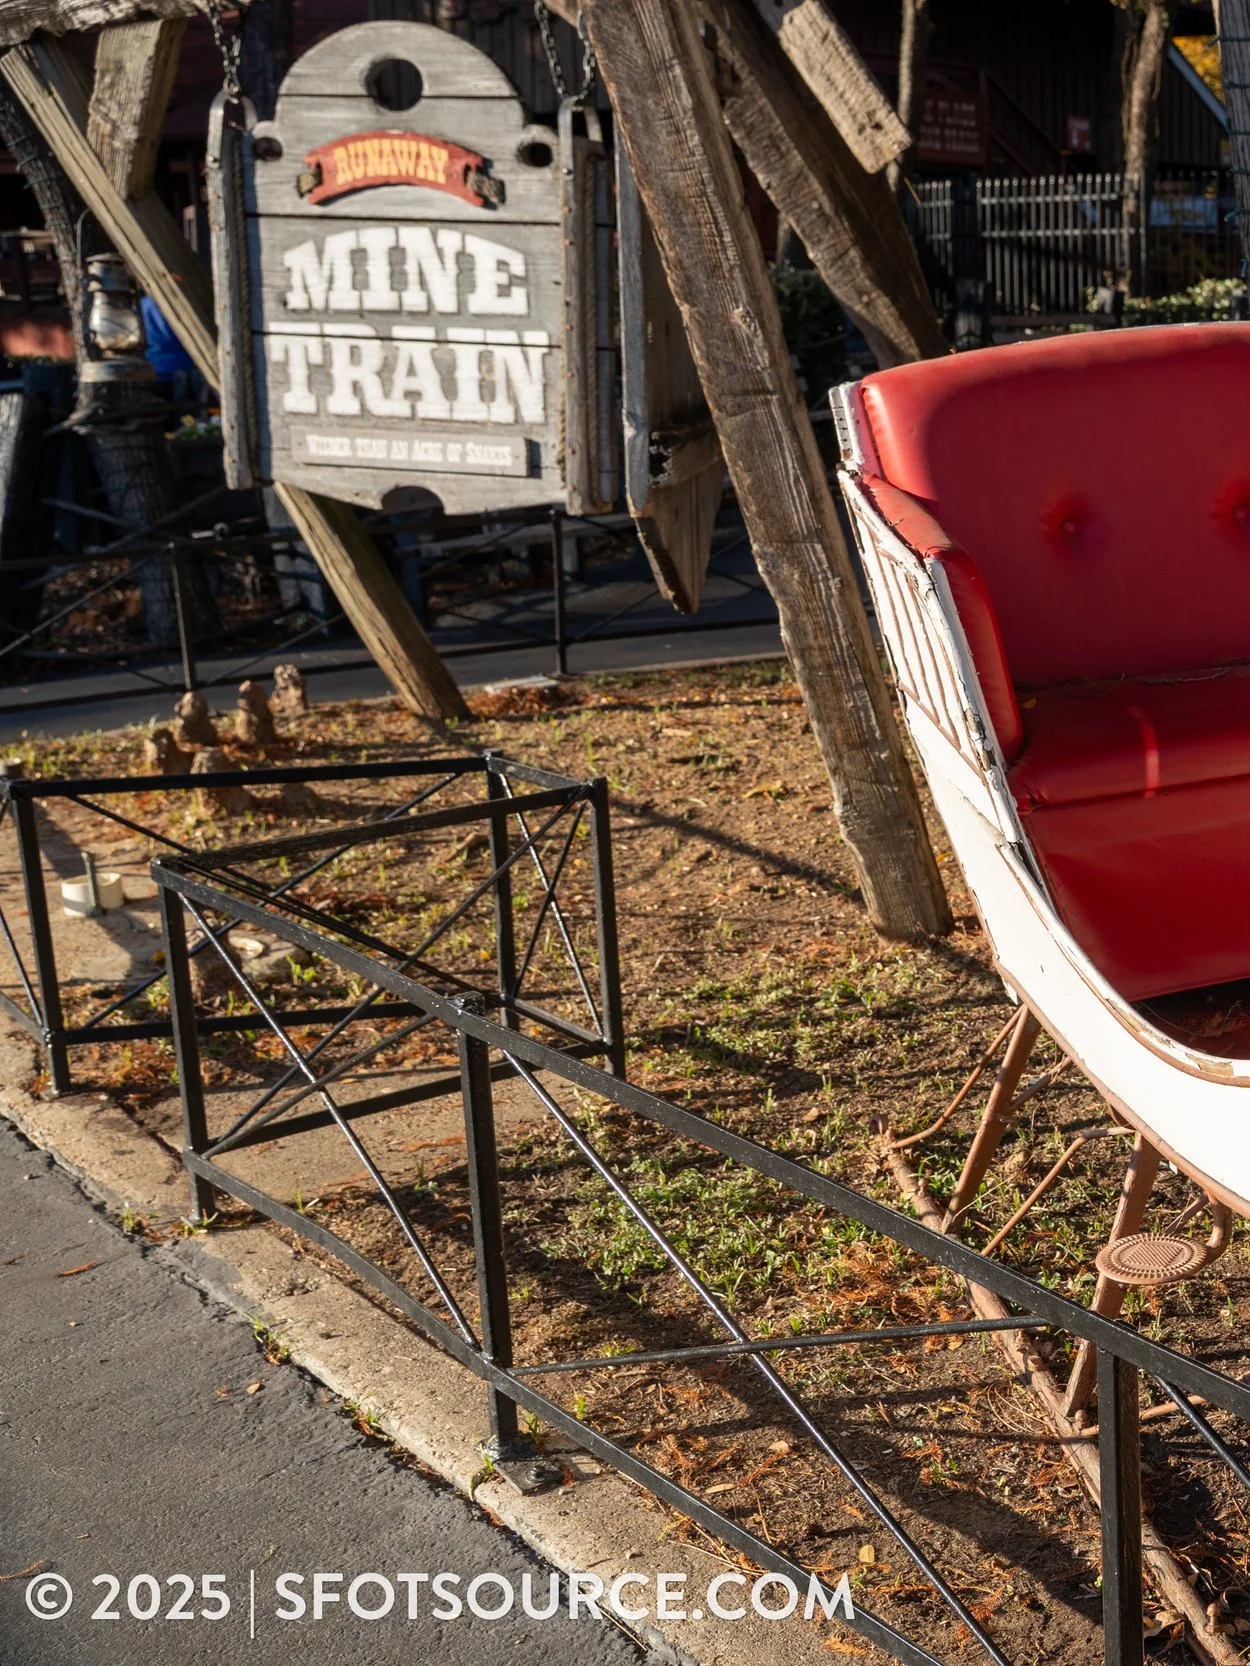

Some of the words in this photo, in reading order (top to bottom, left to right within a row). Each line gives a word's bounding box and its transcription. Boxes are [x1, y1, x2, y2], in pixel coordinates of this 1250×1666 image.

[333, 138, 449, 186] RUNAWAY
[283, 226, 528, 315] MINE
[268, 321, 549, 423] TRAIN
